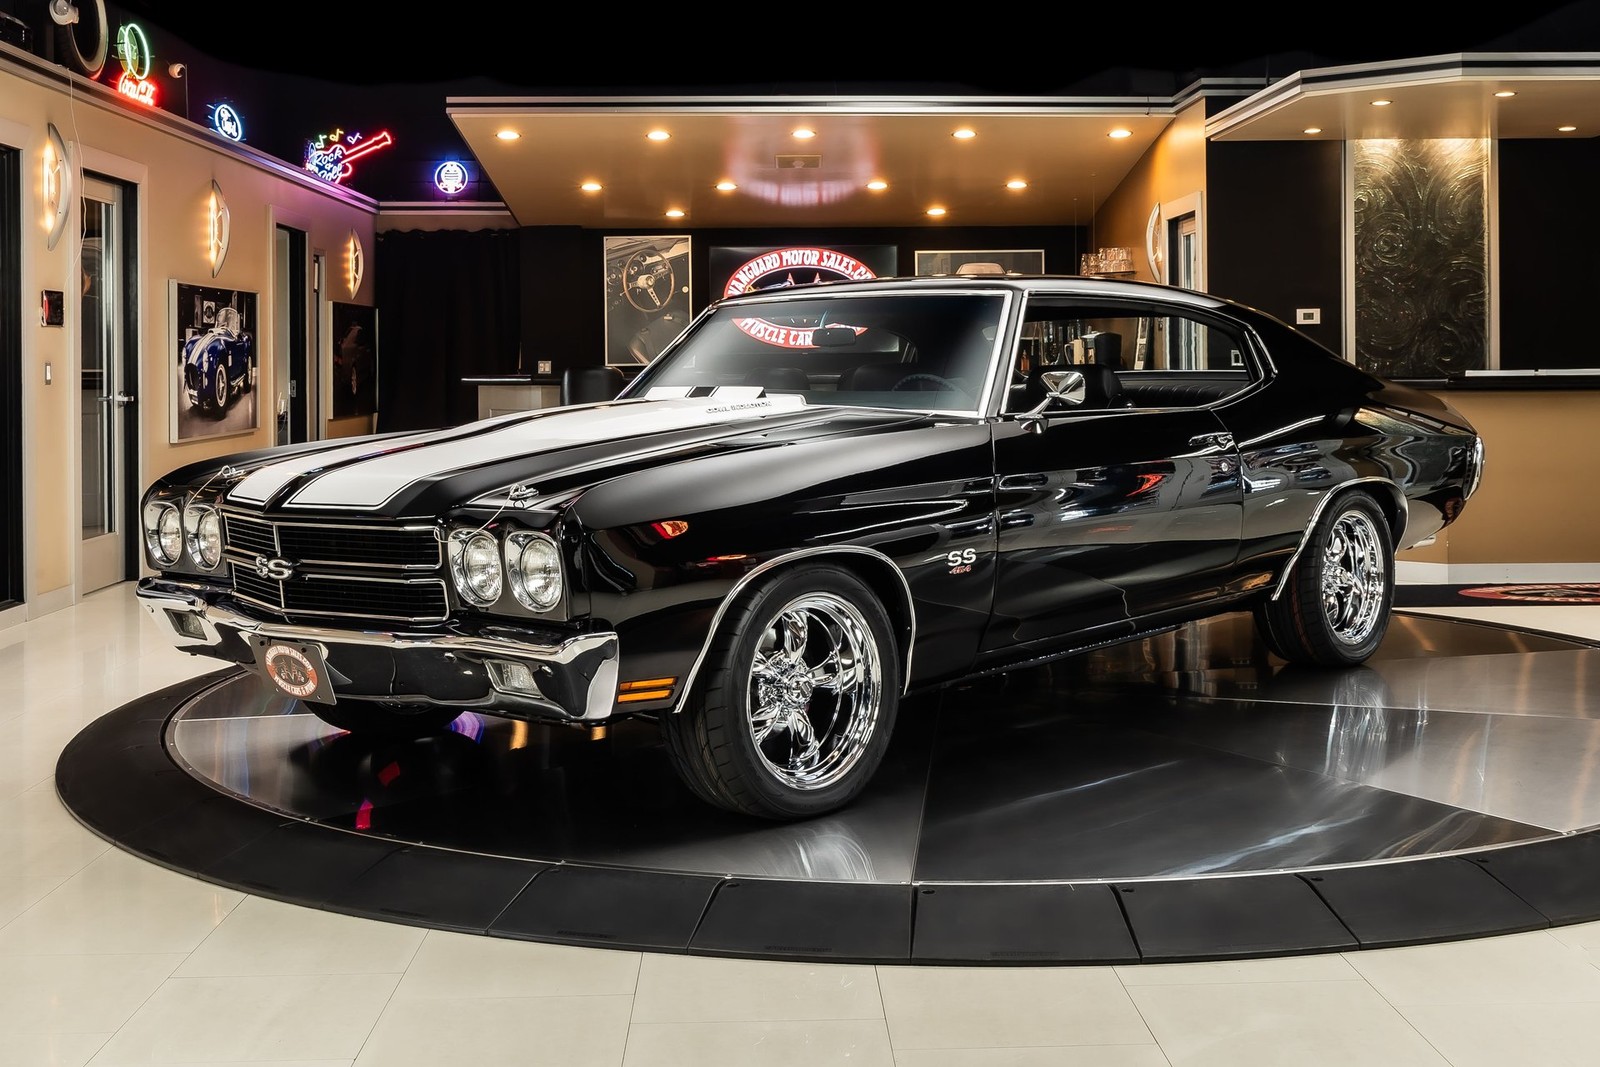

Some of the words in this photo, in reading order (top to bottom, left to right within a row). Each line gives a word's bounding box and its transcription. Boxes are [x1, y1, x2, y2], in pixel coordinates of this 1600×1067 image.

[315, 146, 343, 166] Rock
[780, 250, 820, 266] MOTOR
[820, 251, 873, 280] SALES.CO
[740, 318, 786, 345] MUSCLE
[789, 329, 813, 346] CAR
[948, 548, 977, 567] SS
